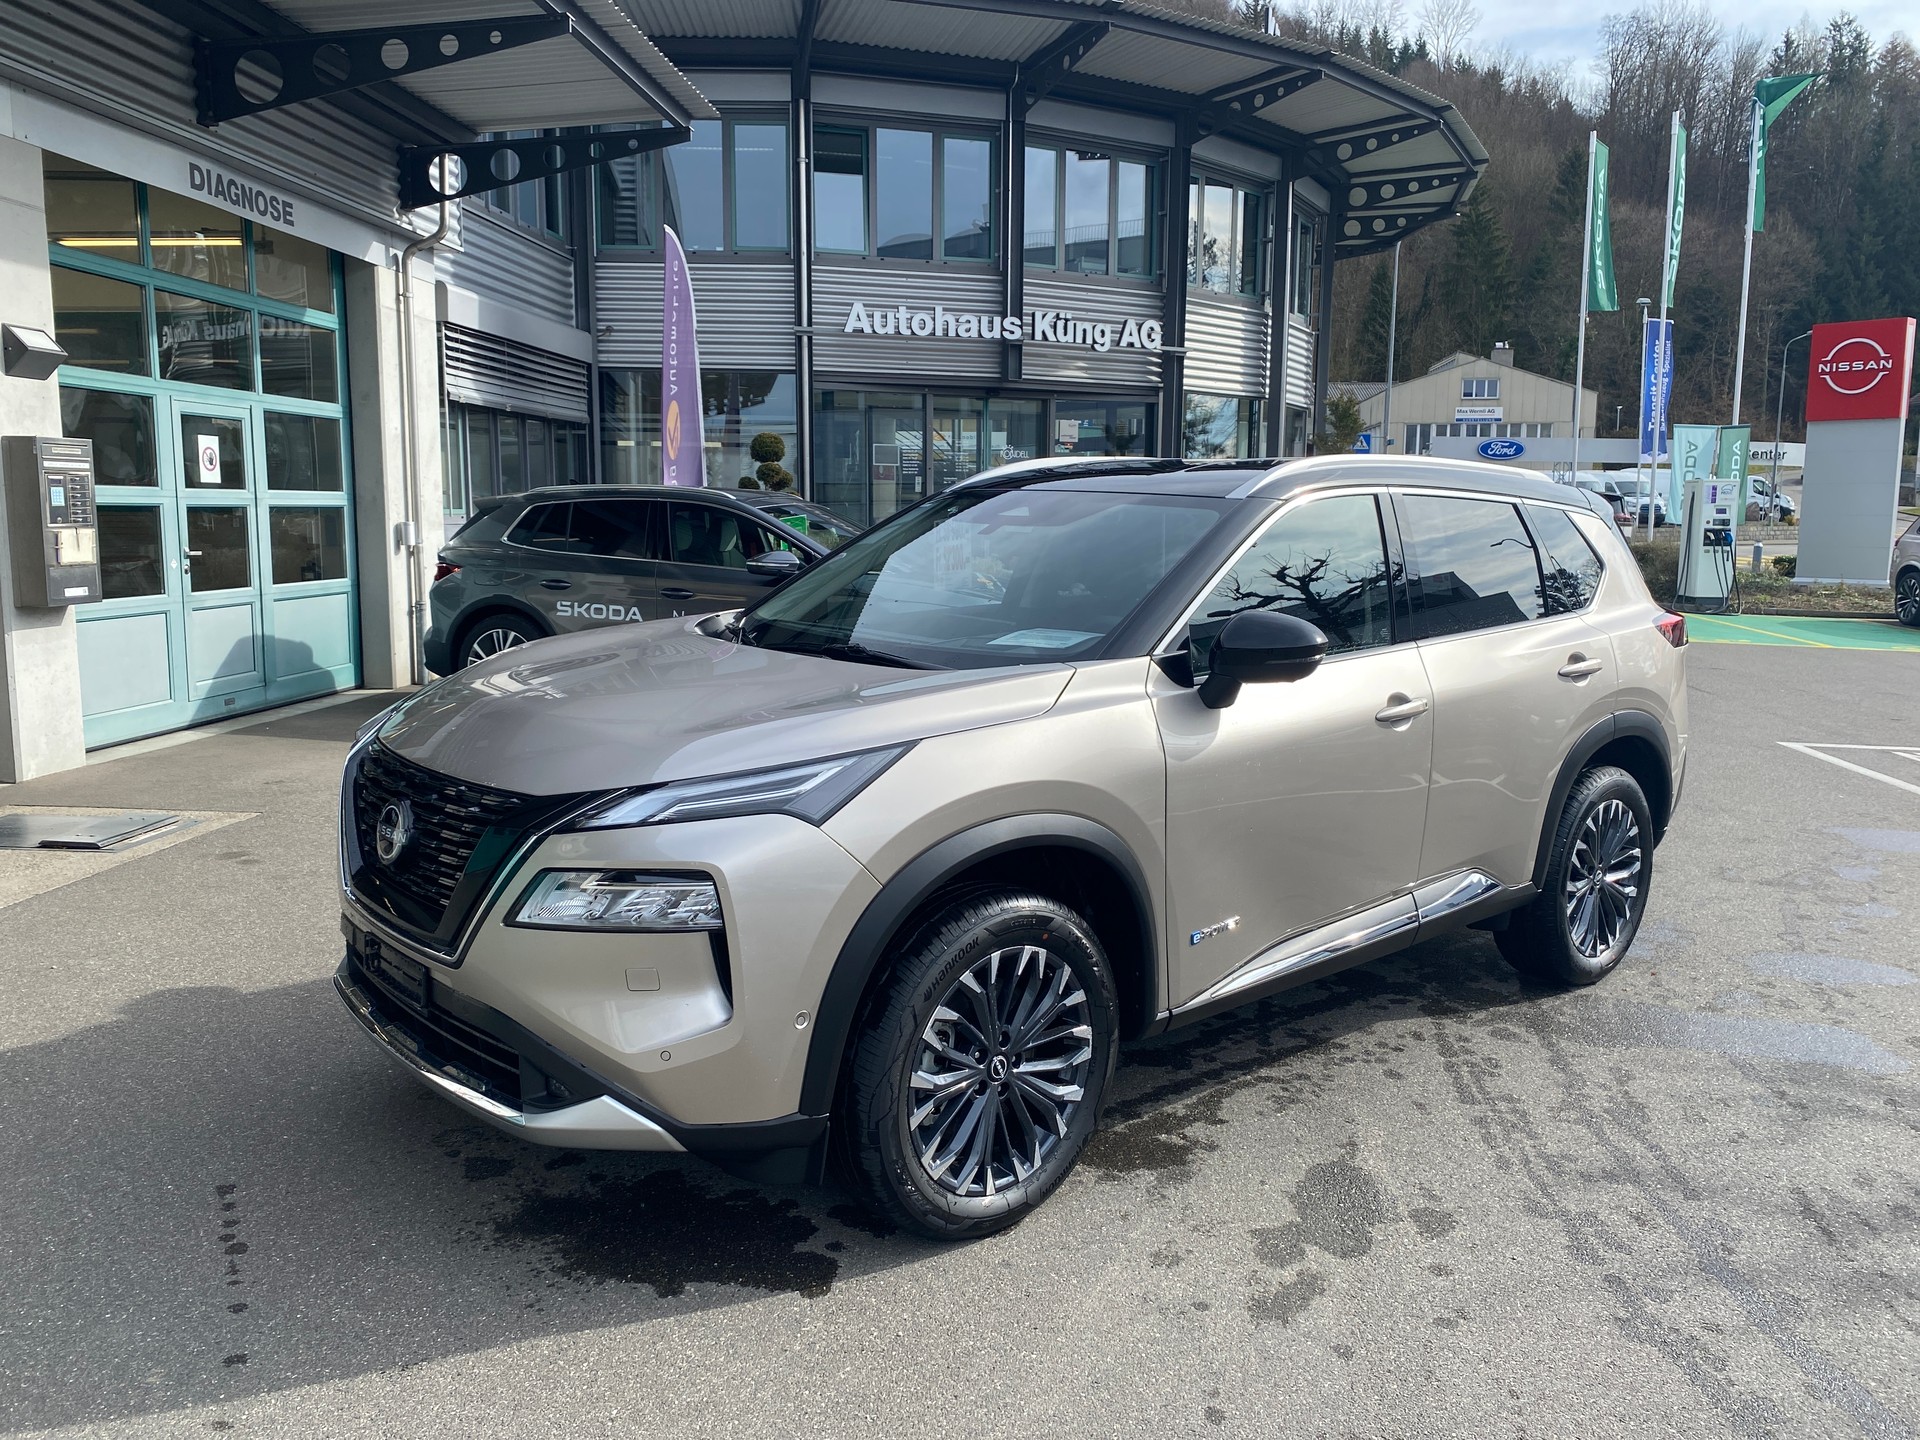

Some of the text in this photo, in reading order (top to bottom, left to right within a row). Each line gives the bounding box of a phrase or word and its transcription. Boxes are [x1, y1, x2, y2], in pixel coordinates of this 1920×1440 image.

[189, 162, 295, 227] DIAGNOSE
[844, 302, 1163, 352] Autohaus Küng AG
[1818, 359, 1893, 373] NISSAN
[1488, 442, 1516, 455] Ford
[1748, 449, 1788, 461] enter
[556, 601, 643, 622] SKODA
